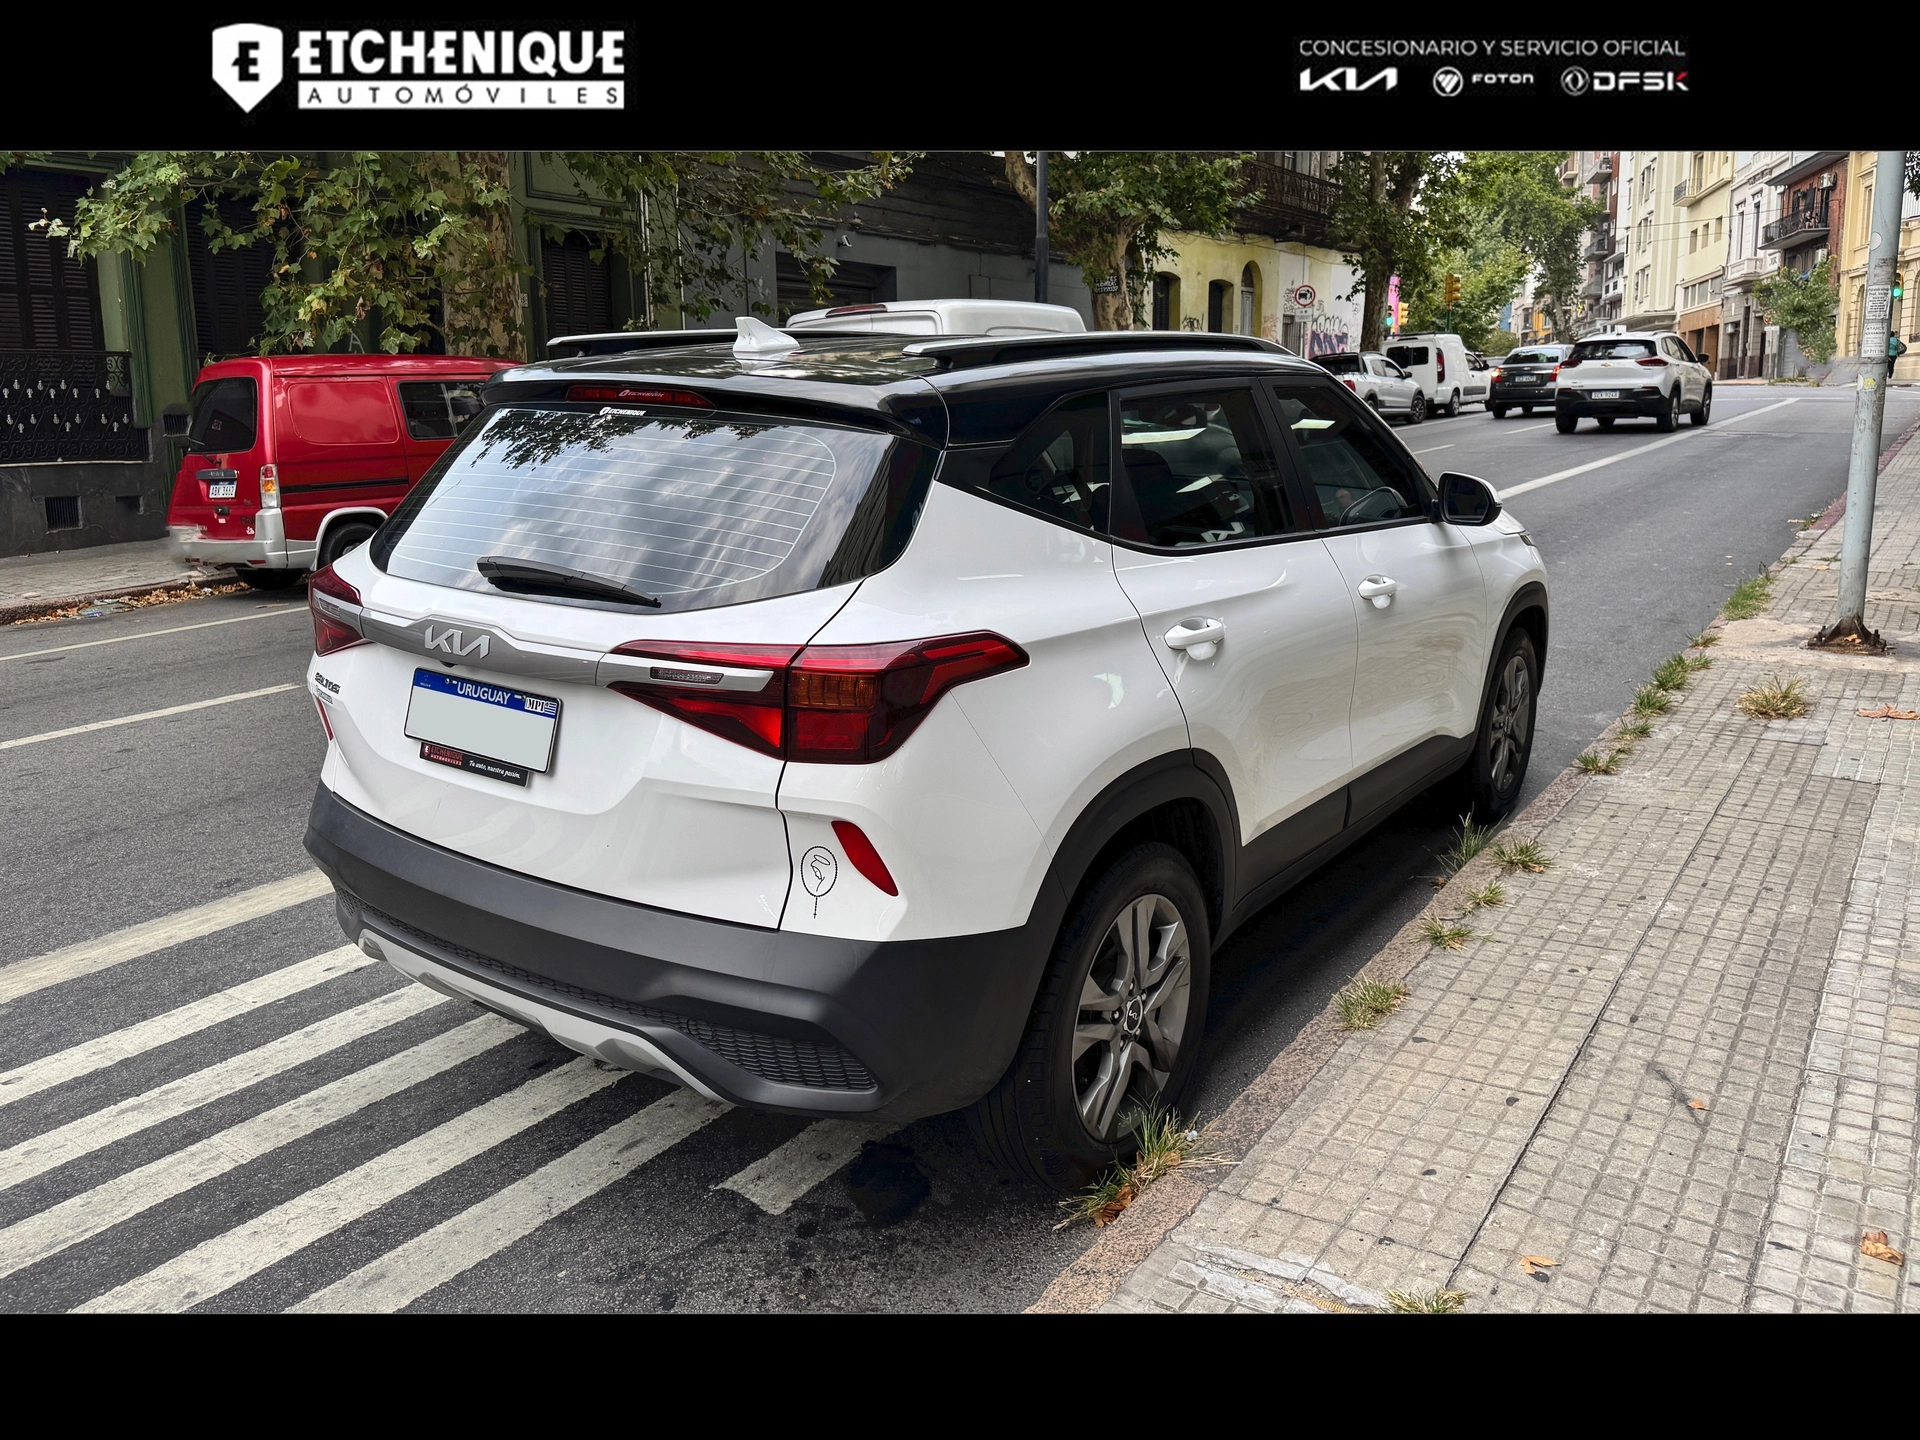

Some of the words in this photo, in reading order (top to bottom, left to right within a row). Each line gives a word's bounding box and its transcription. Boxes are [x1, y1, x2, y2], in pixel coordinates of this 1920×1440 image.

[424, 624, 490, 660] KIA
[457, 682, 512, 705] URUGUAY
[527, 697, 545, 713] MPI
